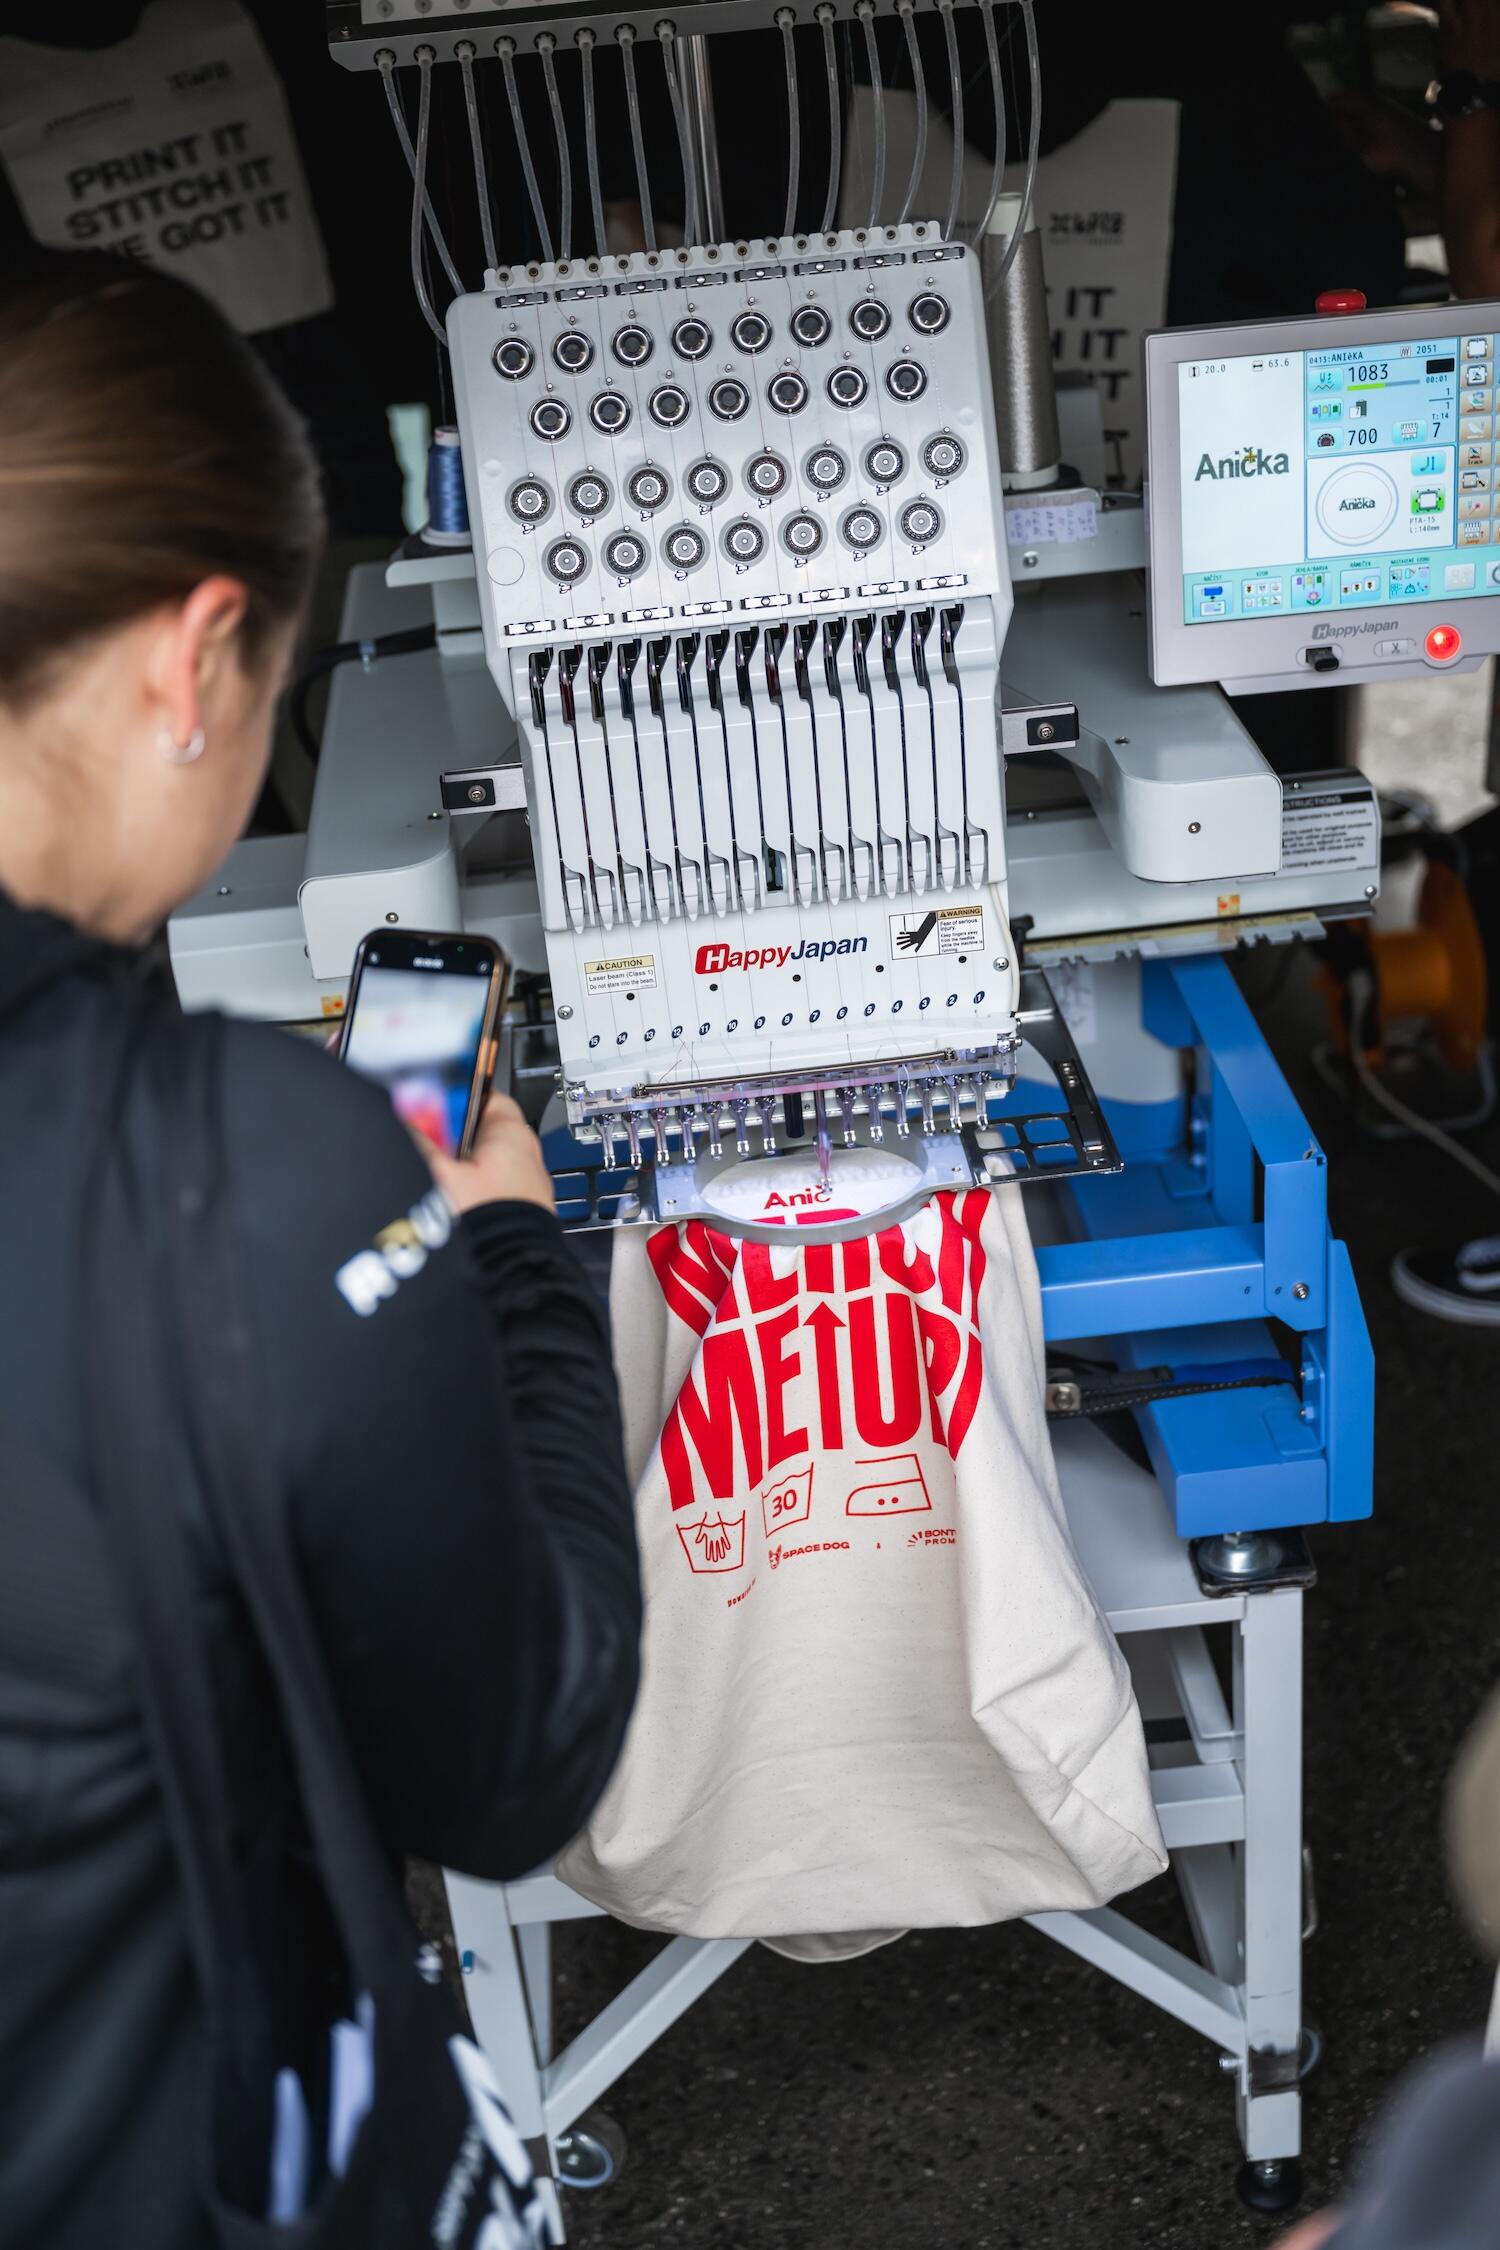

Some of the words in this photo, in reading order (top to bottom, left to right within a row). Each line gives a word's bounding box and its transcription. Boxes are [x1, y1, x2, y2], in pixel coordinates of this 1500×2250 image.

[67, 134, 200, 199] PRINT
[212, 122, 248, 156] IT
[66, 171, 234, 240] STITCH
[237, 157, 273, 190] IT
[160, 204, 245, 253] GOT
[254, 192, 290, 227] IT
[1067, 287, 1114, 317] IT
[1080, 328, 1127, 359] IT
[1416, 344, 1437, 354] 2051
[1205, 364, 1226, 374] 20.0
[1348, 363, 1388, 383] 1083
[1348, 428, 1378, 446] 700
[1432, 422, 1441, 438] 7
[1194, 446, 1289, 481] Anička
[1339, 497, 1376, 511] Anička
[1312, 621, 1398, 640] HappyJapan
[946, 908, 980, 917] WARNING
[605, 959, 643, 970] CAUTION
[695, 936, 868, 975] HappyJapan
[772, 1488, 797, 1518] 30
[924, 1528, 956, 1538] BONT
[782, 1543, 821, 1560] SPACE
[823, 1541, 850, 1551] DOG
